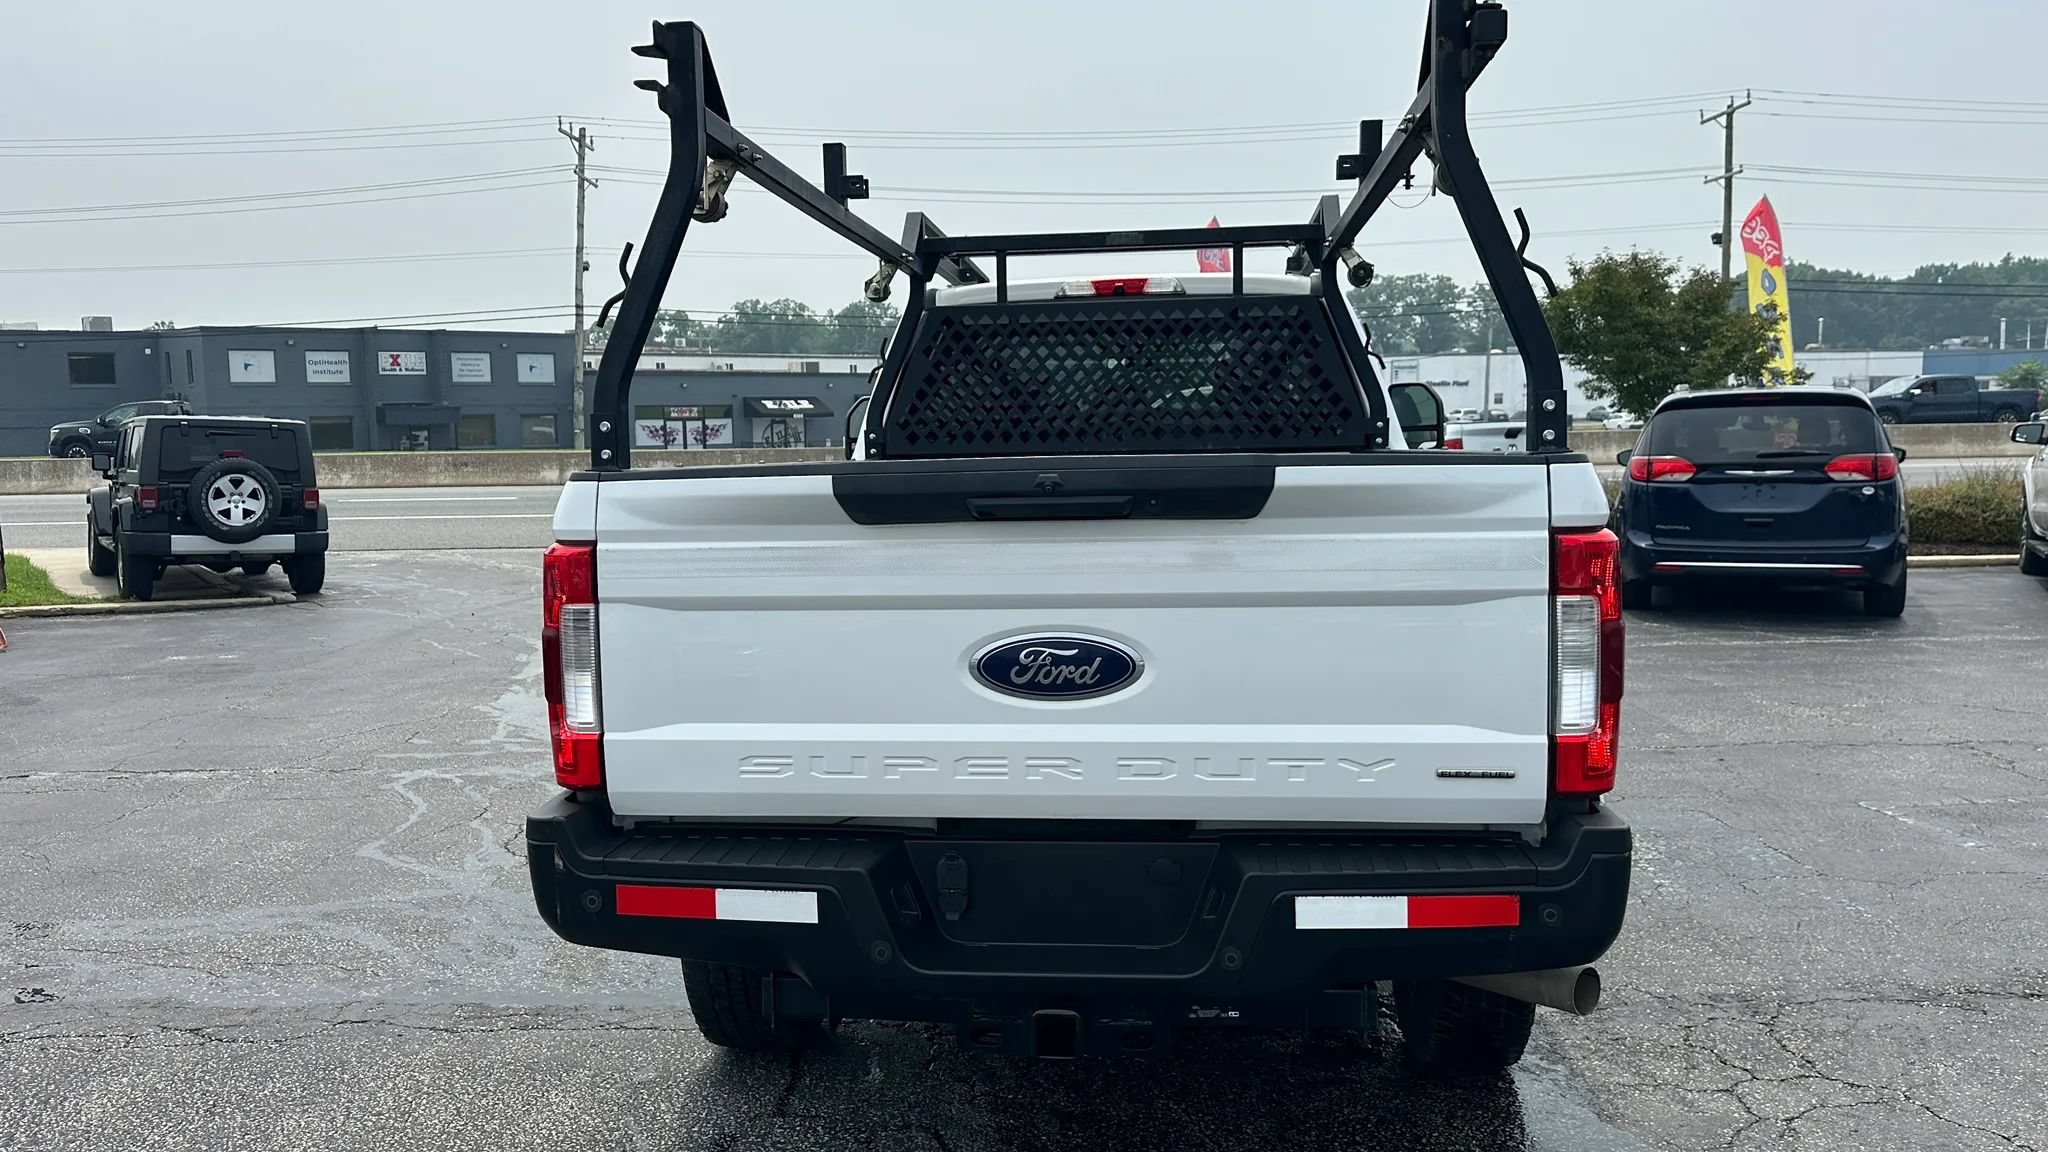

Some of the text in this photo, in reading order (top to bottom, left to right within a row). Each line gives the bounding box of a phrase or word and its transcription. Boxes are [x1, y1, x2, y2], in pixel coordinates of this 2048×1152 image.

[307, 358, 348, 367] OptiHealth
[1010, 647, 1103, 684] Ford
[738, 755, 1396, 782] SUPER DUTY
[1440, 770, 1513, 779] FLEX FUEL
